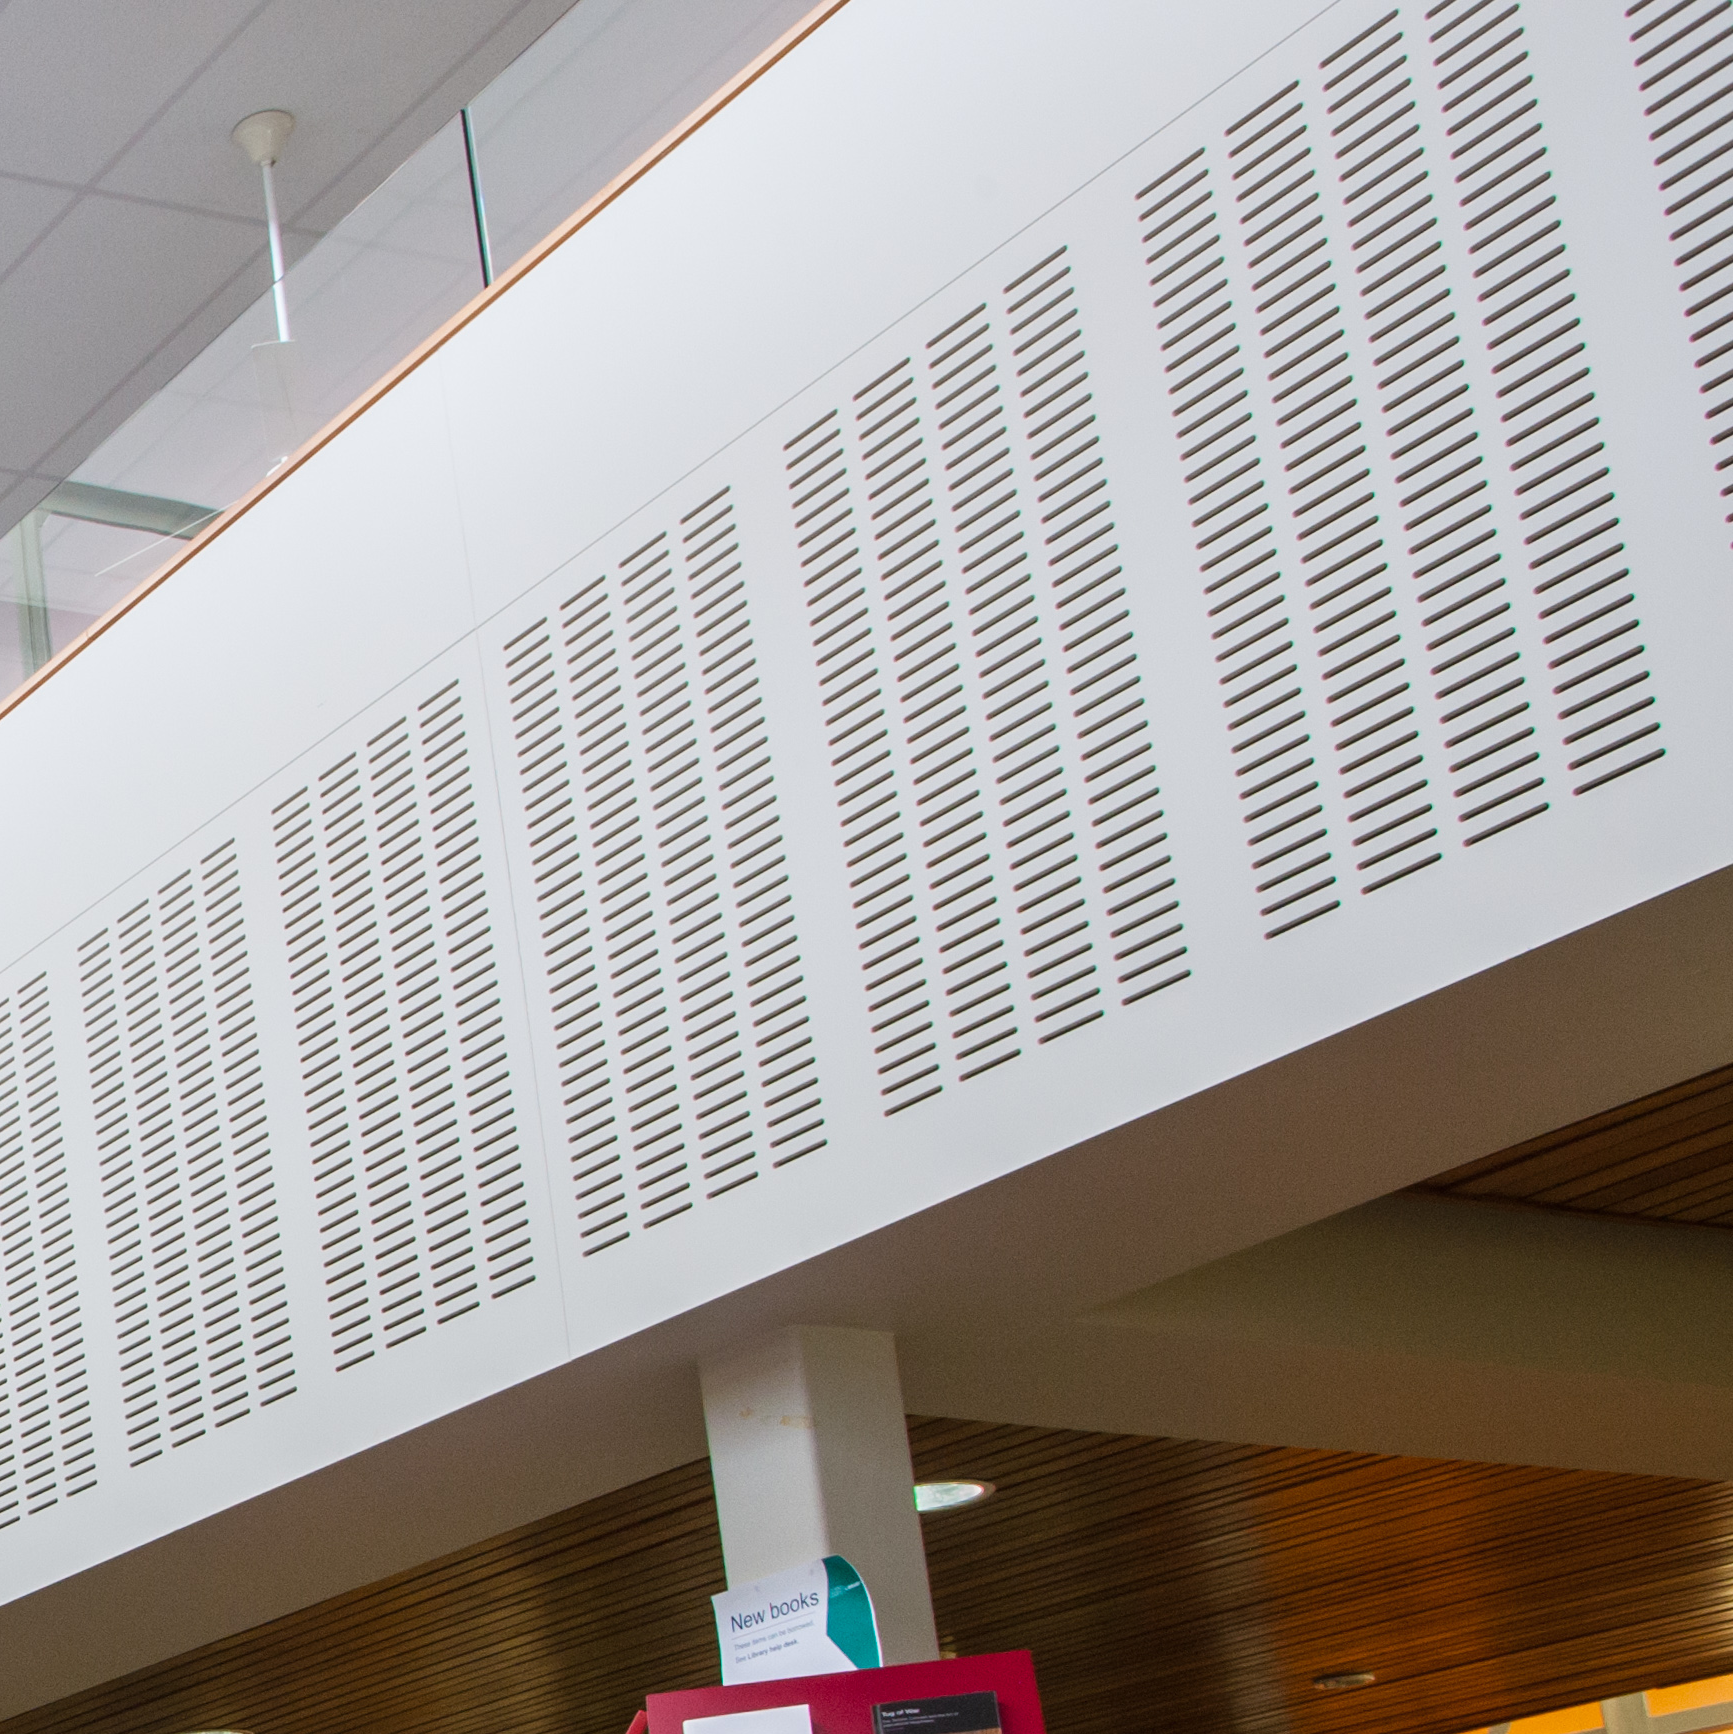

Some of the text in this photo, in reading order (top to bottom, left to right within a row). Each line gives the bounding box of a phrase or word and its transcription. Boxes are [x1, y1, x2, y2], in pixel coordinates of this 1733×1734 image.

[730, 1591, 819, 1633] New books
[748, 1648, 768, 1661] Library
[769, 1644, 782, 1654] help
